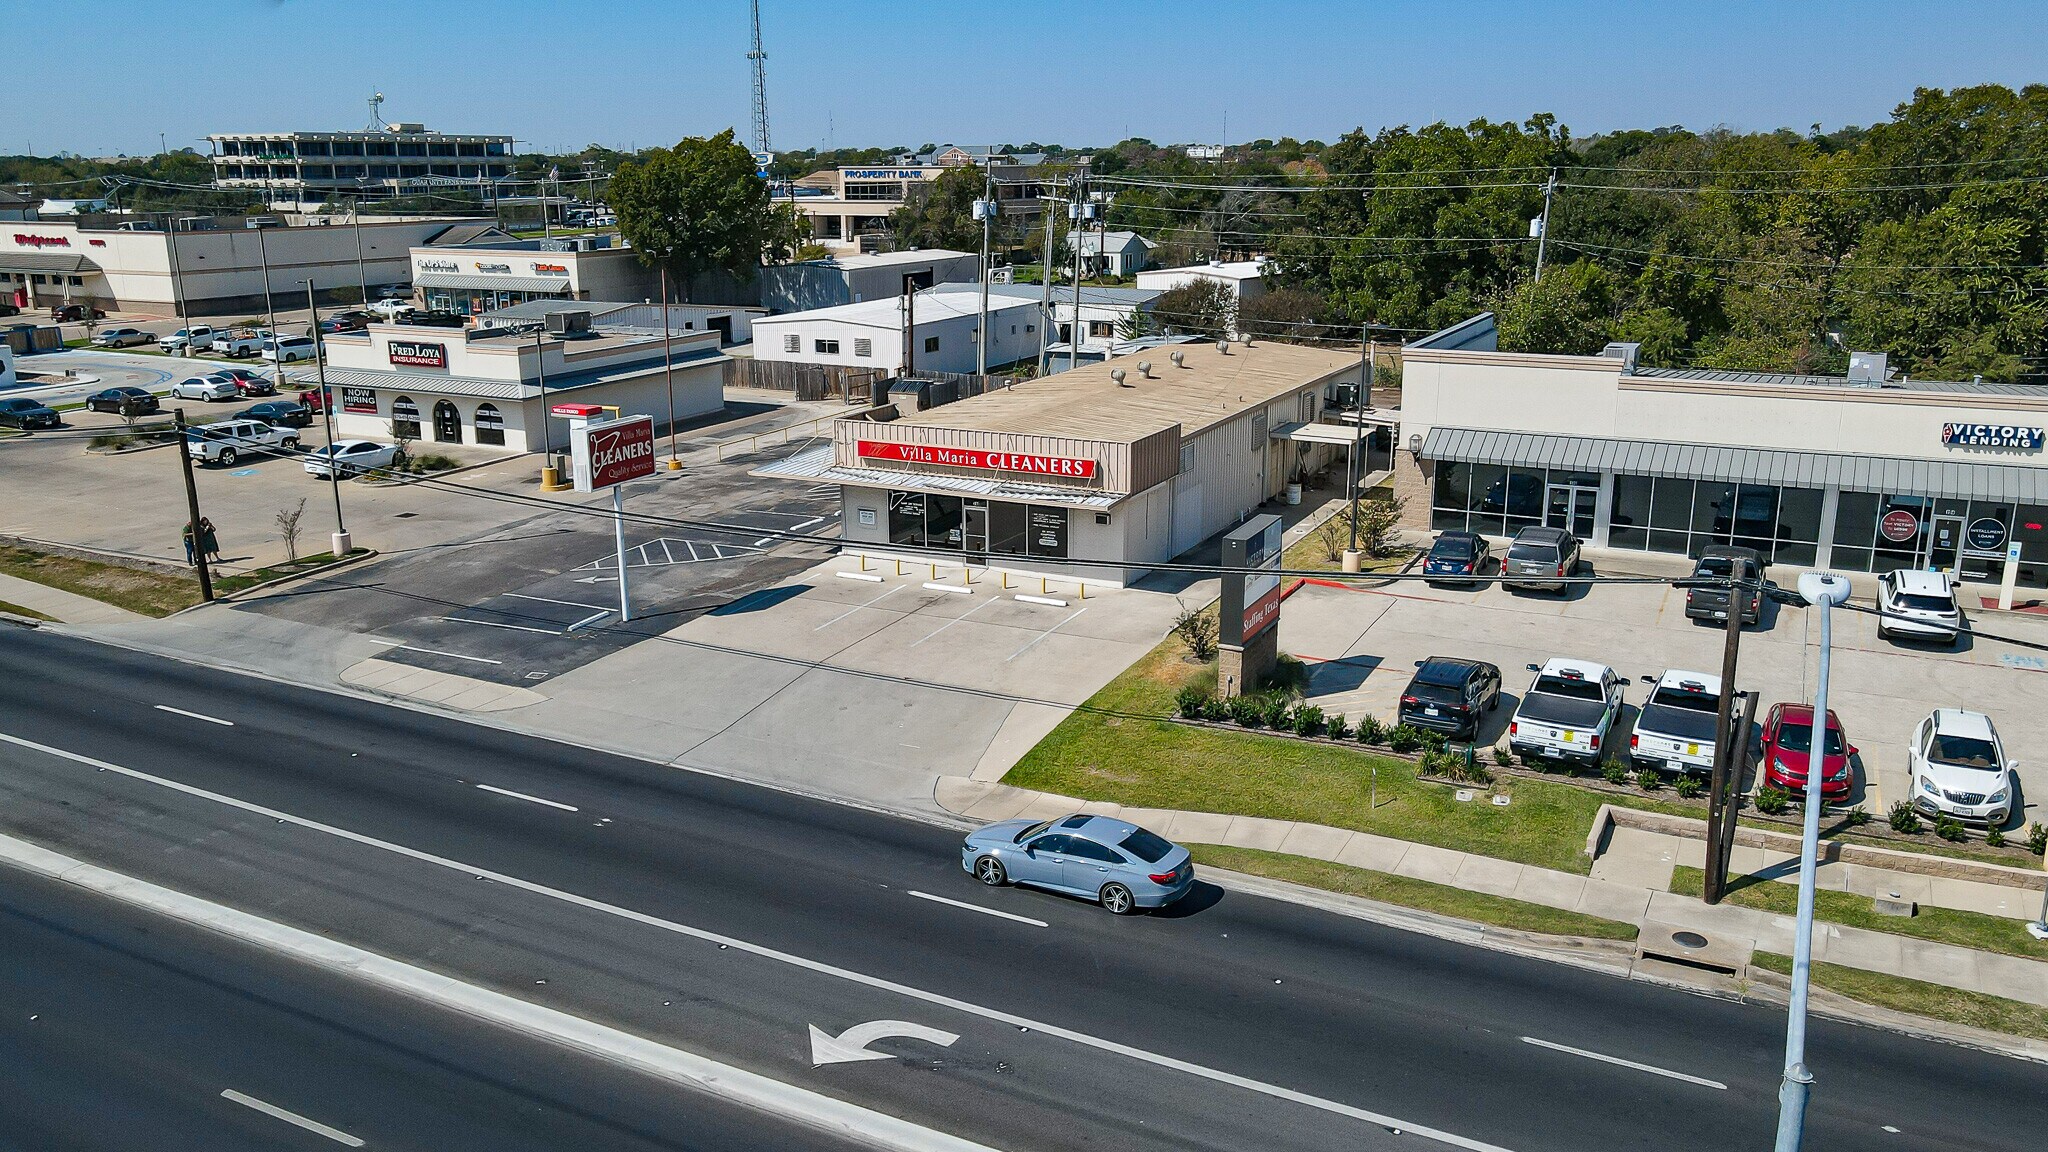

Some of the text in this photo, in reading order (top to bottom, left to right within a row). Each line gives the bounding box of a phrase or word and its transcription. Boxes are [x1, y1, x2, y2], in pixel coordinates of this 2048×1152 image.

[844, 170, 923, 179] PROSPERITY BANK
[390, 342, 440, 358] FRED LOYA
[393, 356, 440, 365] INSURANCE
[344, 395, 376, 404] HIRING
[347, 388, 370, 397] NOW
[622, 431, 634, 440] Villa
[1952, 423, 2043, 440] VICTORY
[1960, 435, 2031, 448] LENDING
[592, 440, 652, 467] CLEANERS
[899, 446, 1084, 475] Villa Maria CLEANERS
[608, 461, 652, 478] Quality Service
[1243, 598, 1278, 633] Staffing Texas
